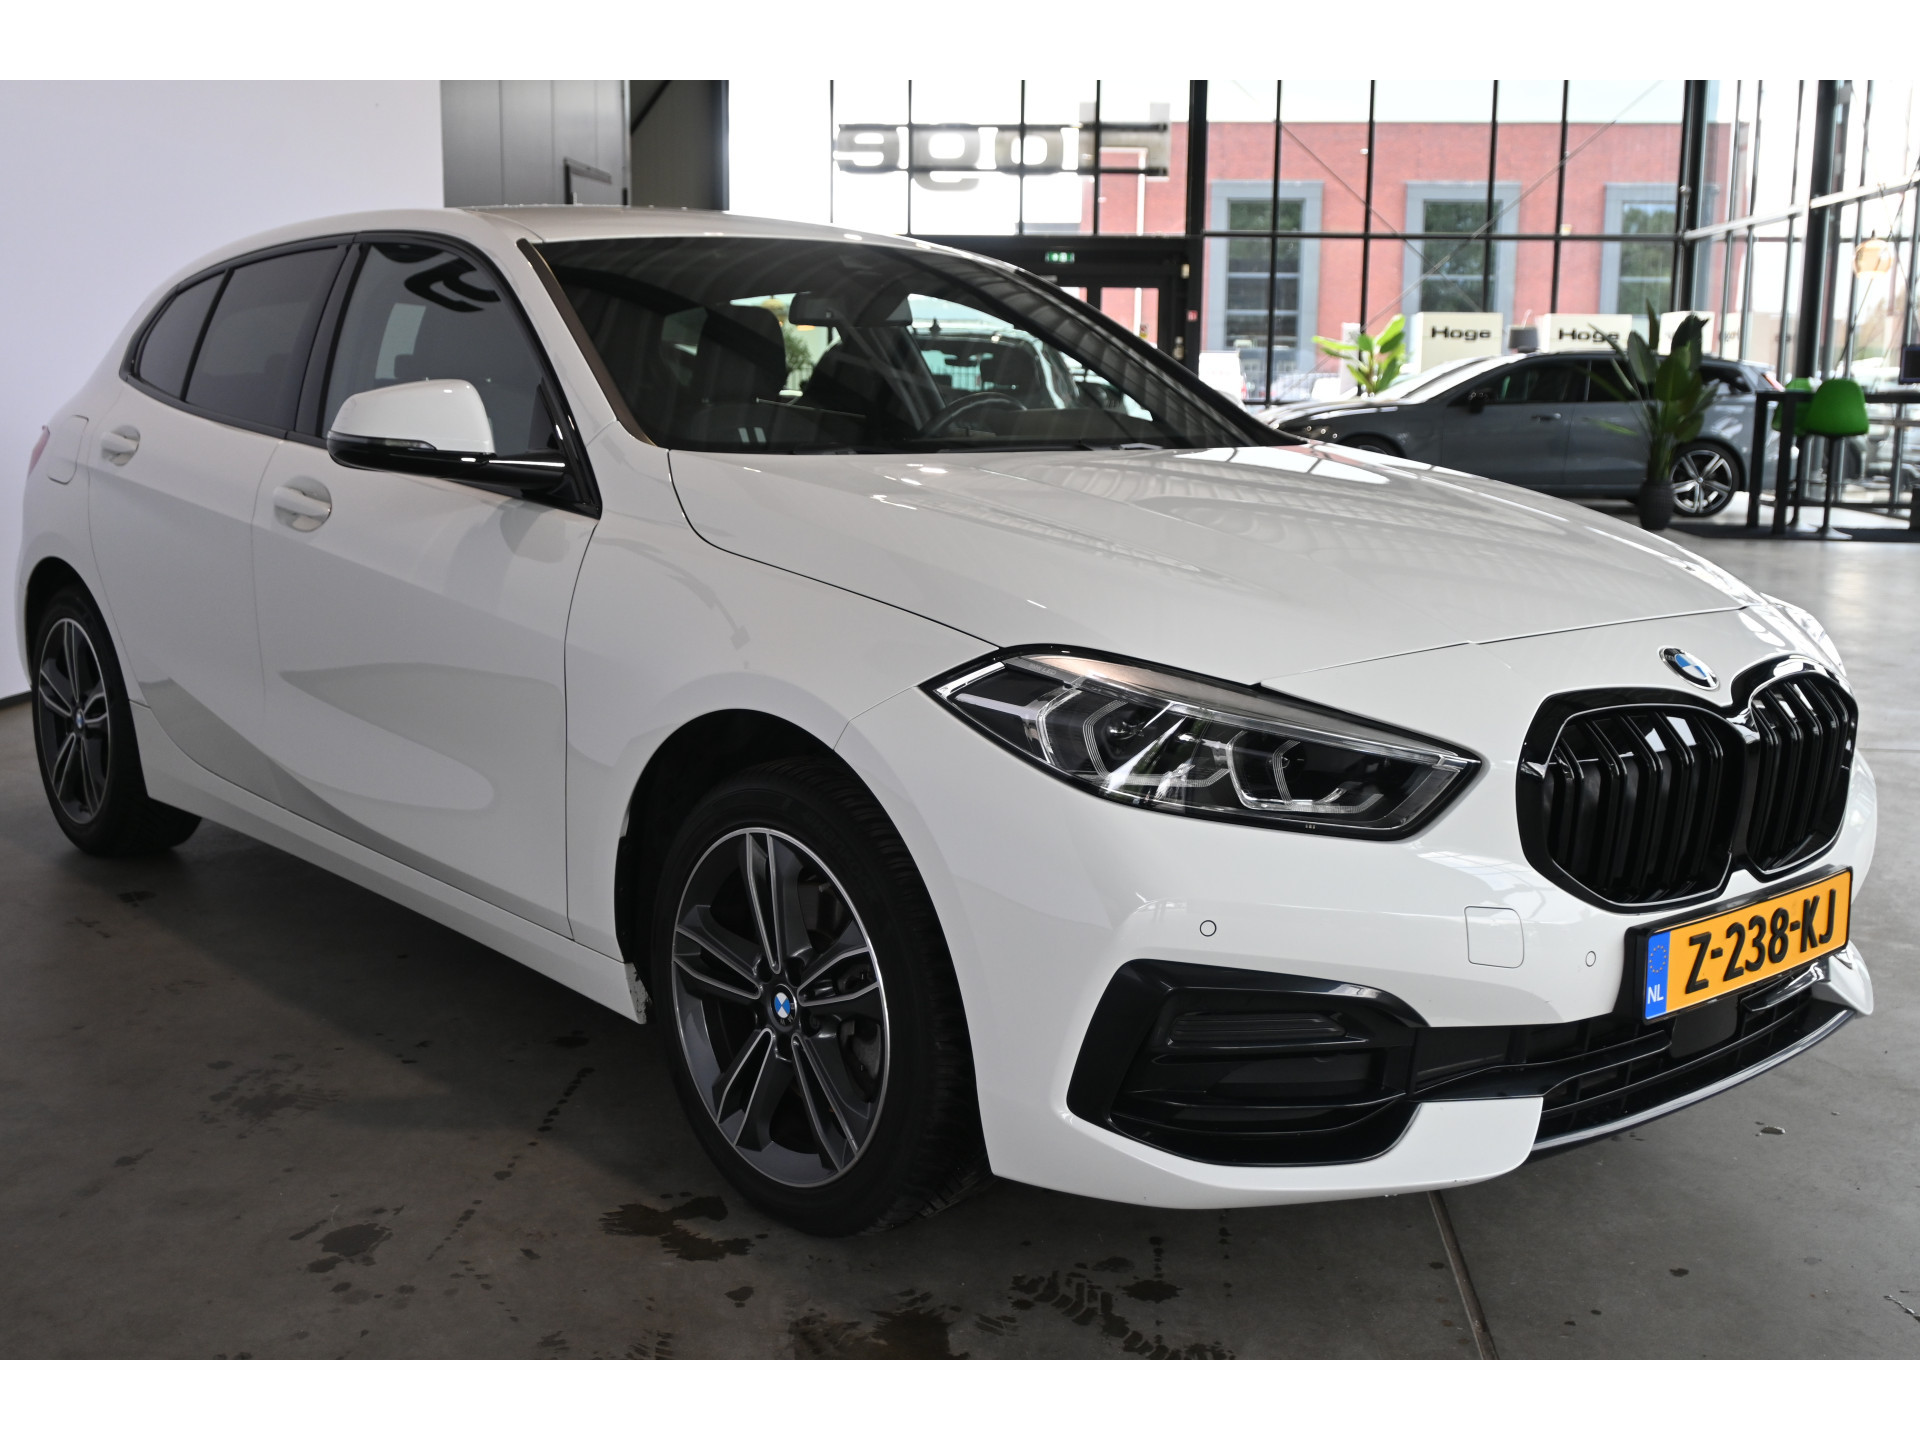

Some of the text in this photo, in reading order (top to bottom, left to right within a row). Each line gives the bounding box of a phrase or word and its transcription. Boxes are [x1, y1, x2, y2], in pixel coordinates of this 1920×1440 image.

[1431, 326, 1491, 341] Hoge
[1685, 888, 1836, 994] Z-238-KJ
[1647, 984, 1664, 1004] NL
